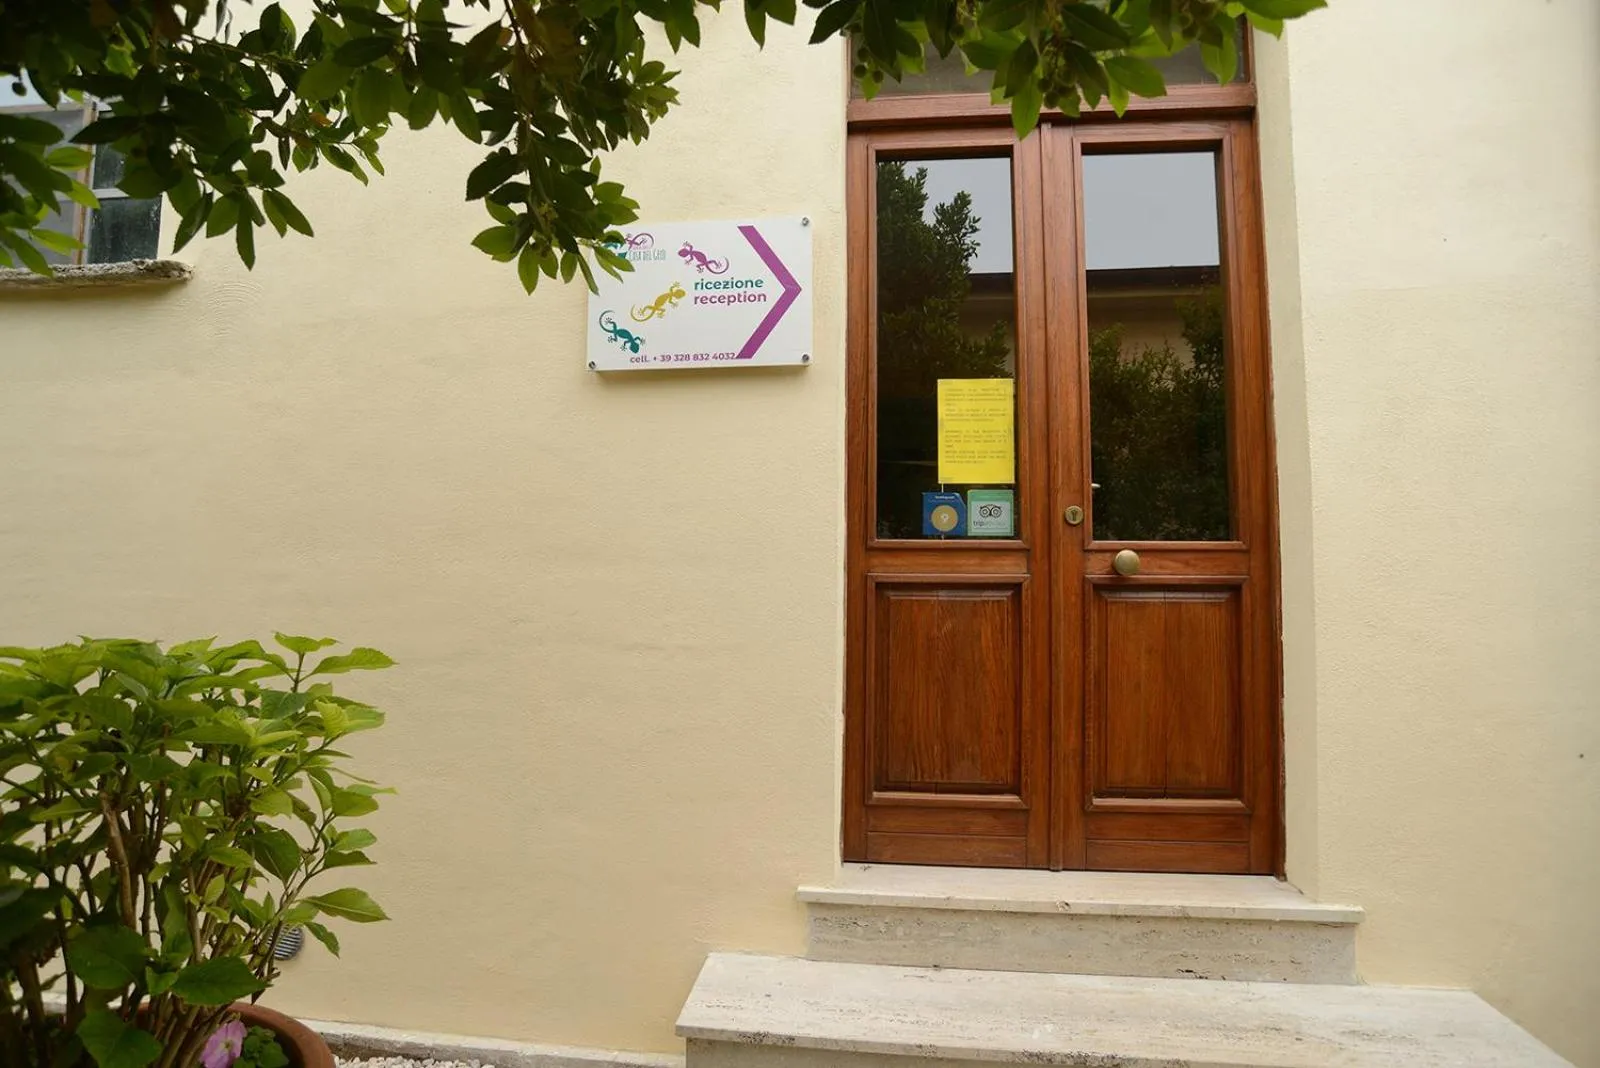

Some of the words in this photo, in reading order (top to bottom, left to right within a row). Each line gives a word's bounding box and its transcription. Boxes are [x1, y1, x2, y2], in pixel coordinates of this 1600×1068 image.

[694, 276, 764, 290] ricezione
[694, 291, 767, 305] reception
[629, 355, 649, 364] cell.
[660, 354, 672, 362] 39
[673, 354, 690, 362] 328
[693, 353, 710, 361] 832
[711, 352, 736, 360] 4032
